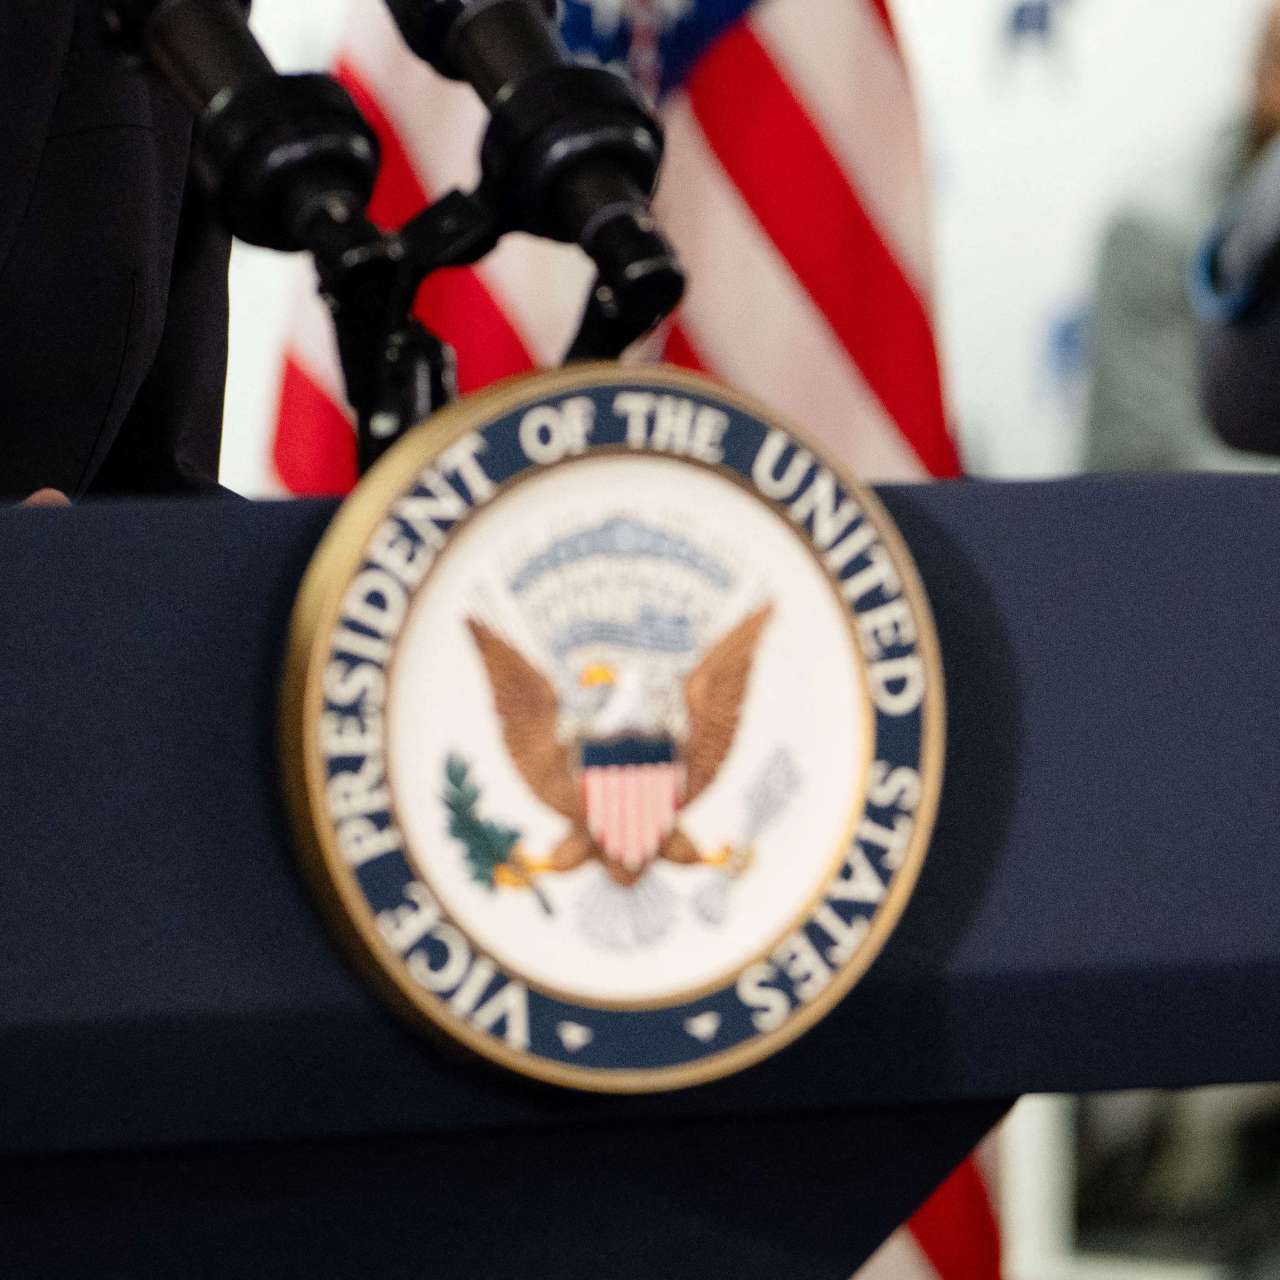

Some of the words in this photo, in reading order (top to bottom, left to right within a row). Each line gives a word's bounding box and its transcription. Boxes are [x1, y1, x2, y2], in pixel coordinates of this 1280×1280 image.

[521, 396, 596, 465] OF
[615, 392, 729, 461] THE
[323, 430, 498, 867] PRESIDENT
[752, 431, 924, 717] UNITED
[376, 882, 529, 1052] VICE
[738, 759, 919, 1033] STATES
